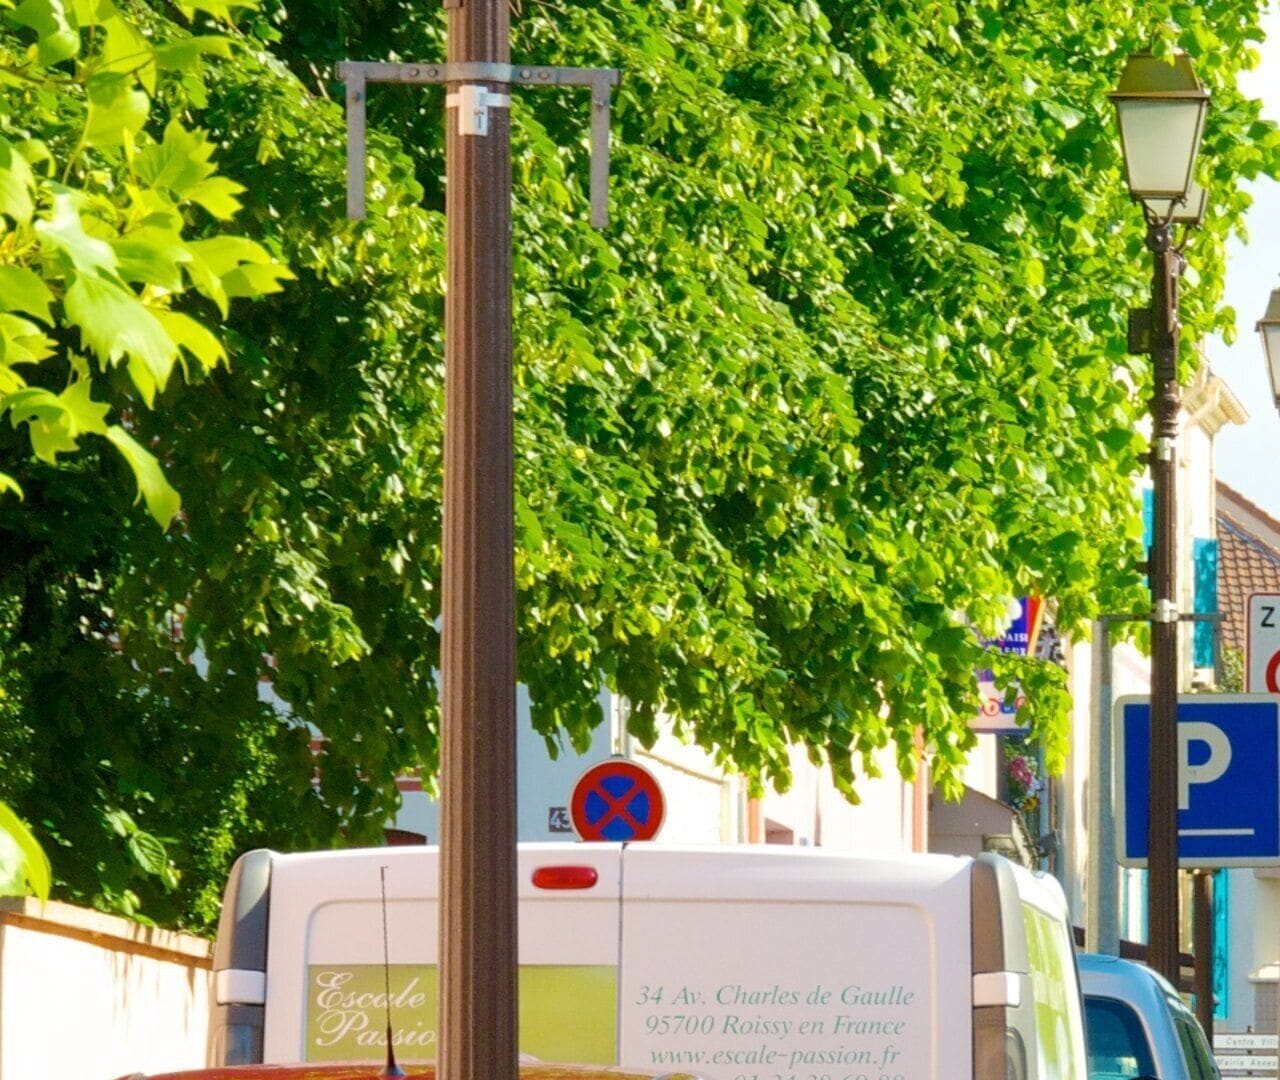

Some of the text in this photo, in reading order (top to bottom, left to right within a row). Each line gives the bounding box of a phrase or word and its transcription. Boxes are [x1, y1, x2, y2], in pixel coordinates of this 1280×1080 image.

[1176, 721, 1233, 810] P
[316, 971, 426, 1008] Escale
[635, 984, 915, 1006] 34 Av. Charles de Gaulle
[316, 1008, 439, 1046] Passio
[645, 1015, 906, 1040] 95700 Roissy en France
[650, 1045, 902, 1071] www.escale-passion.fr
